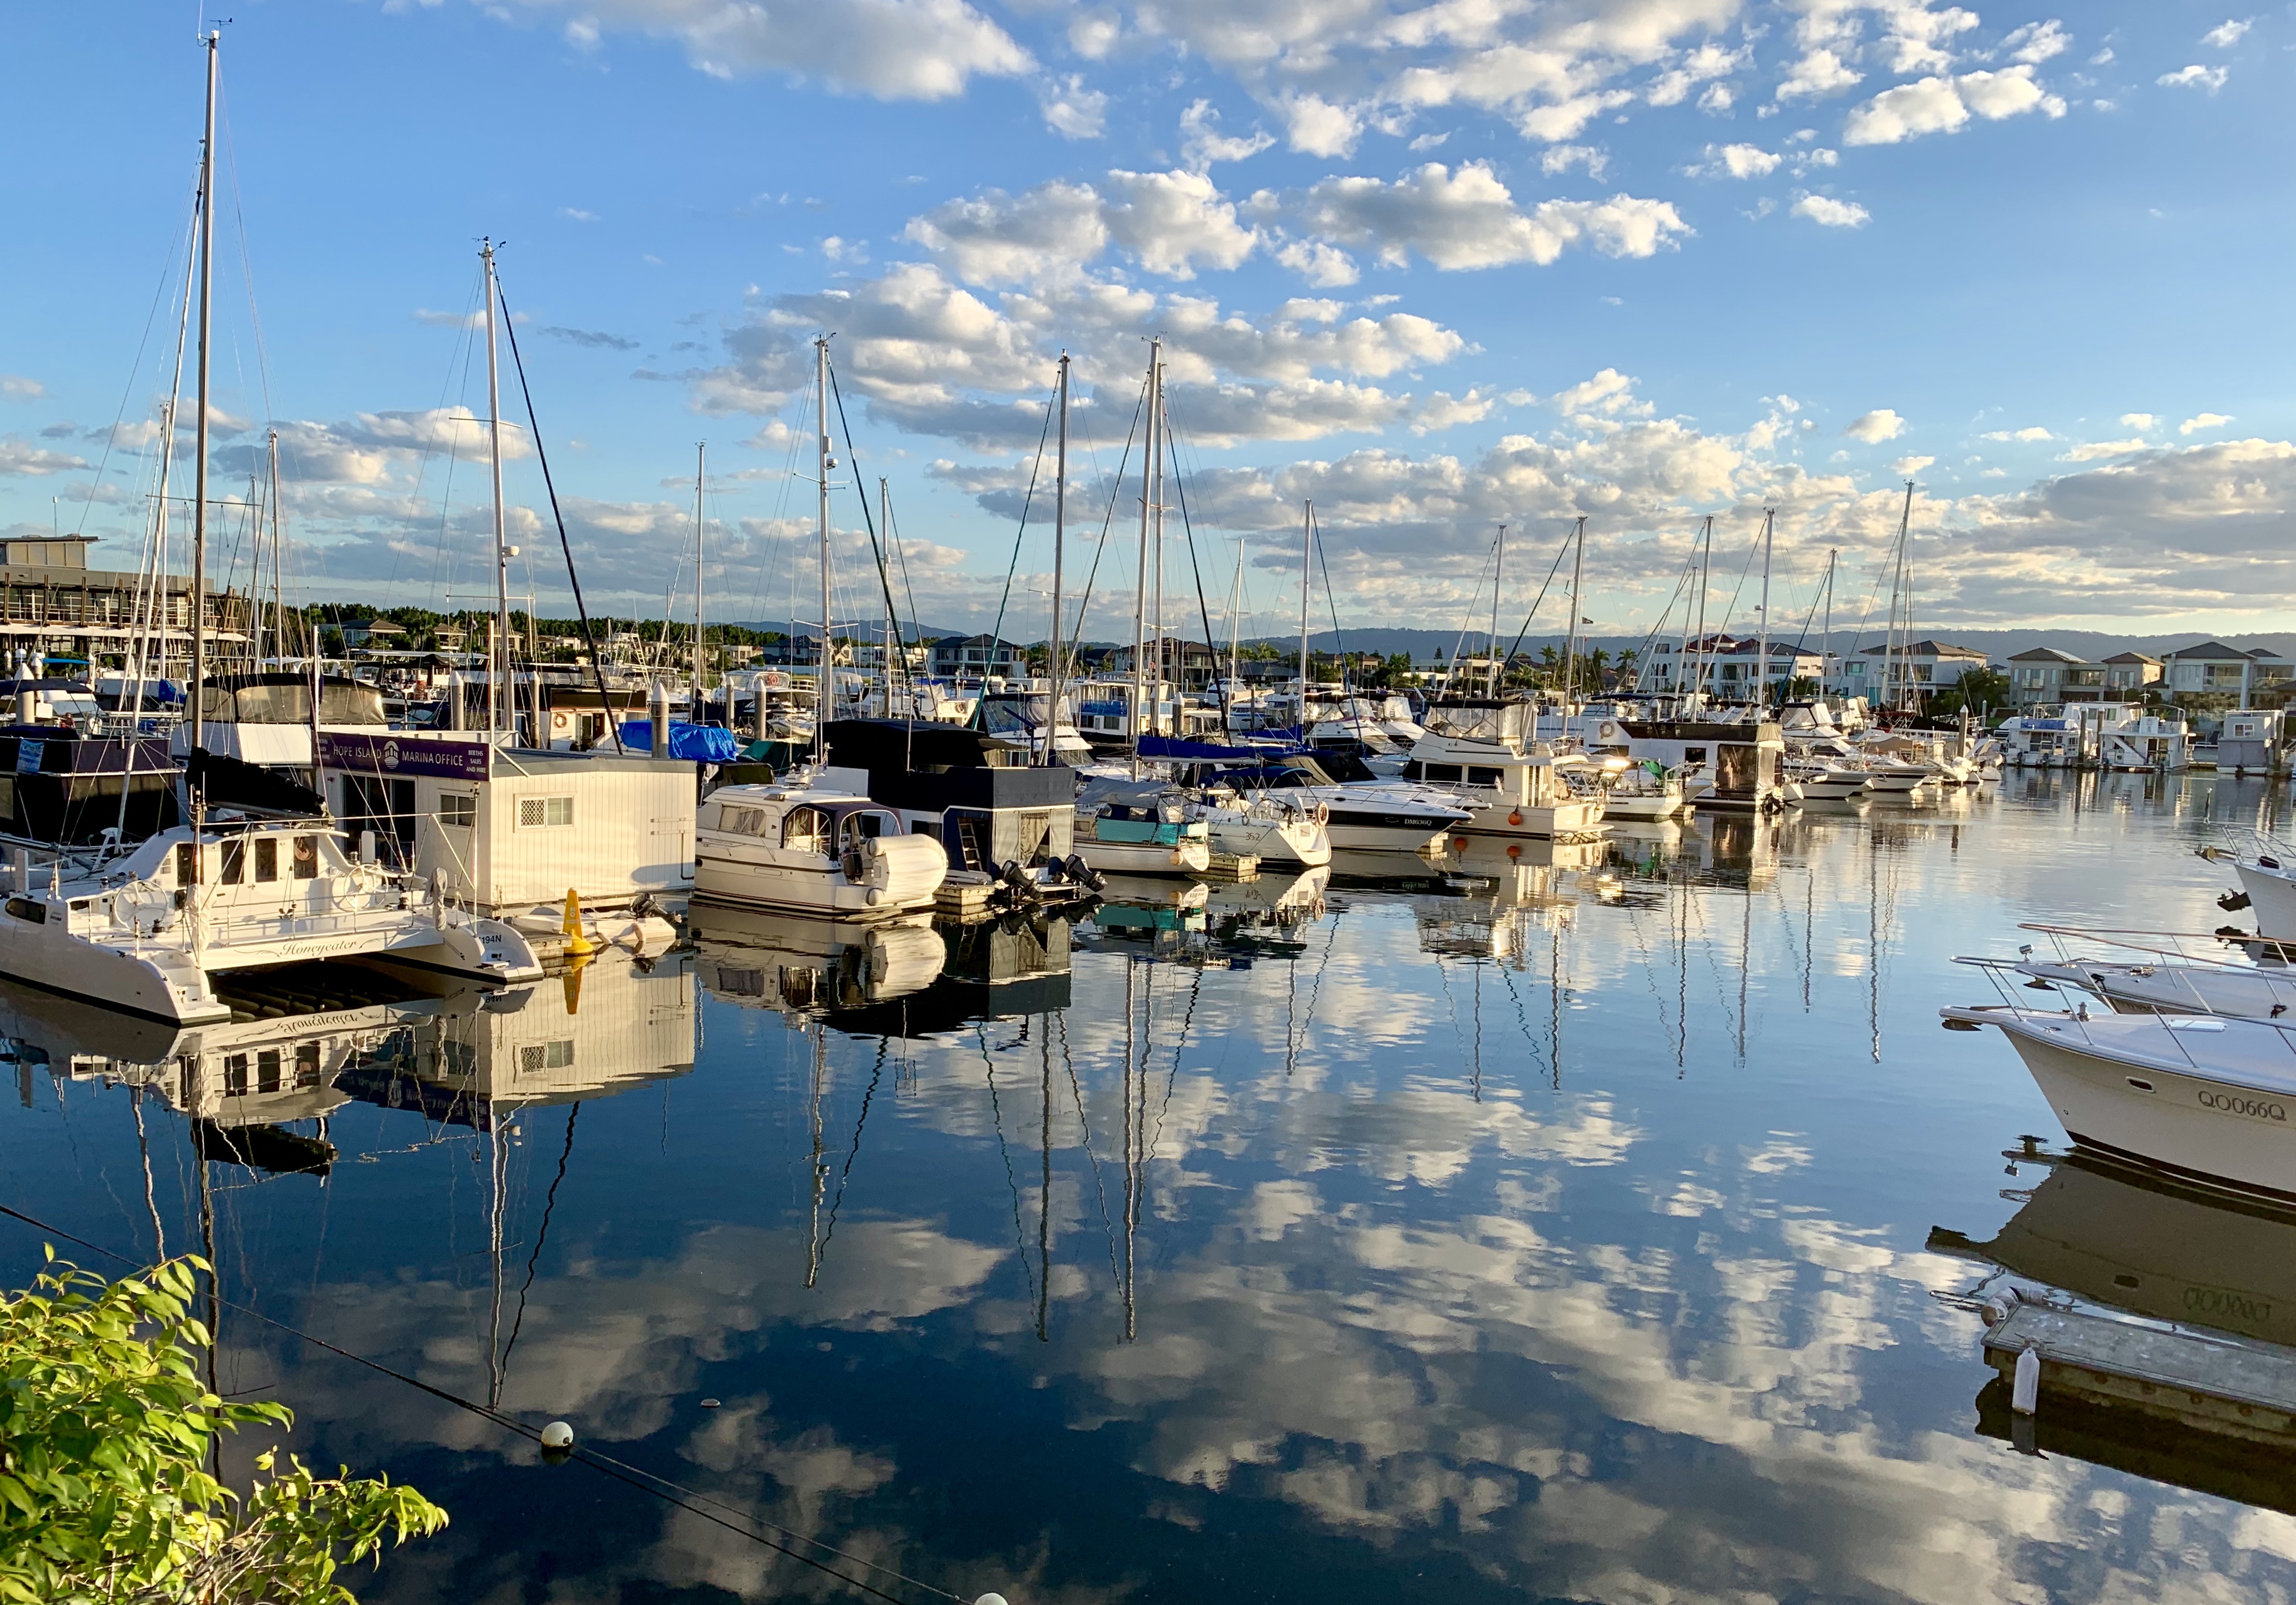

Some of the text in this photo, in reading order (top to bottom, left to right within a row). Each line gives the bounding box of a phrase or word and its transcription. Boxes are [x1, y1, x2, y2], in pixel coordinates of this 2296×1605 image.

[333, 746, 463, 766] HOPE ISLAND MARINA OFFICE
[479, 935, 501, 944] 194N
[280, 940, 357, 957] Honeyeater
